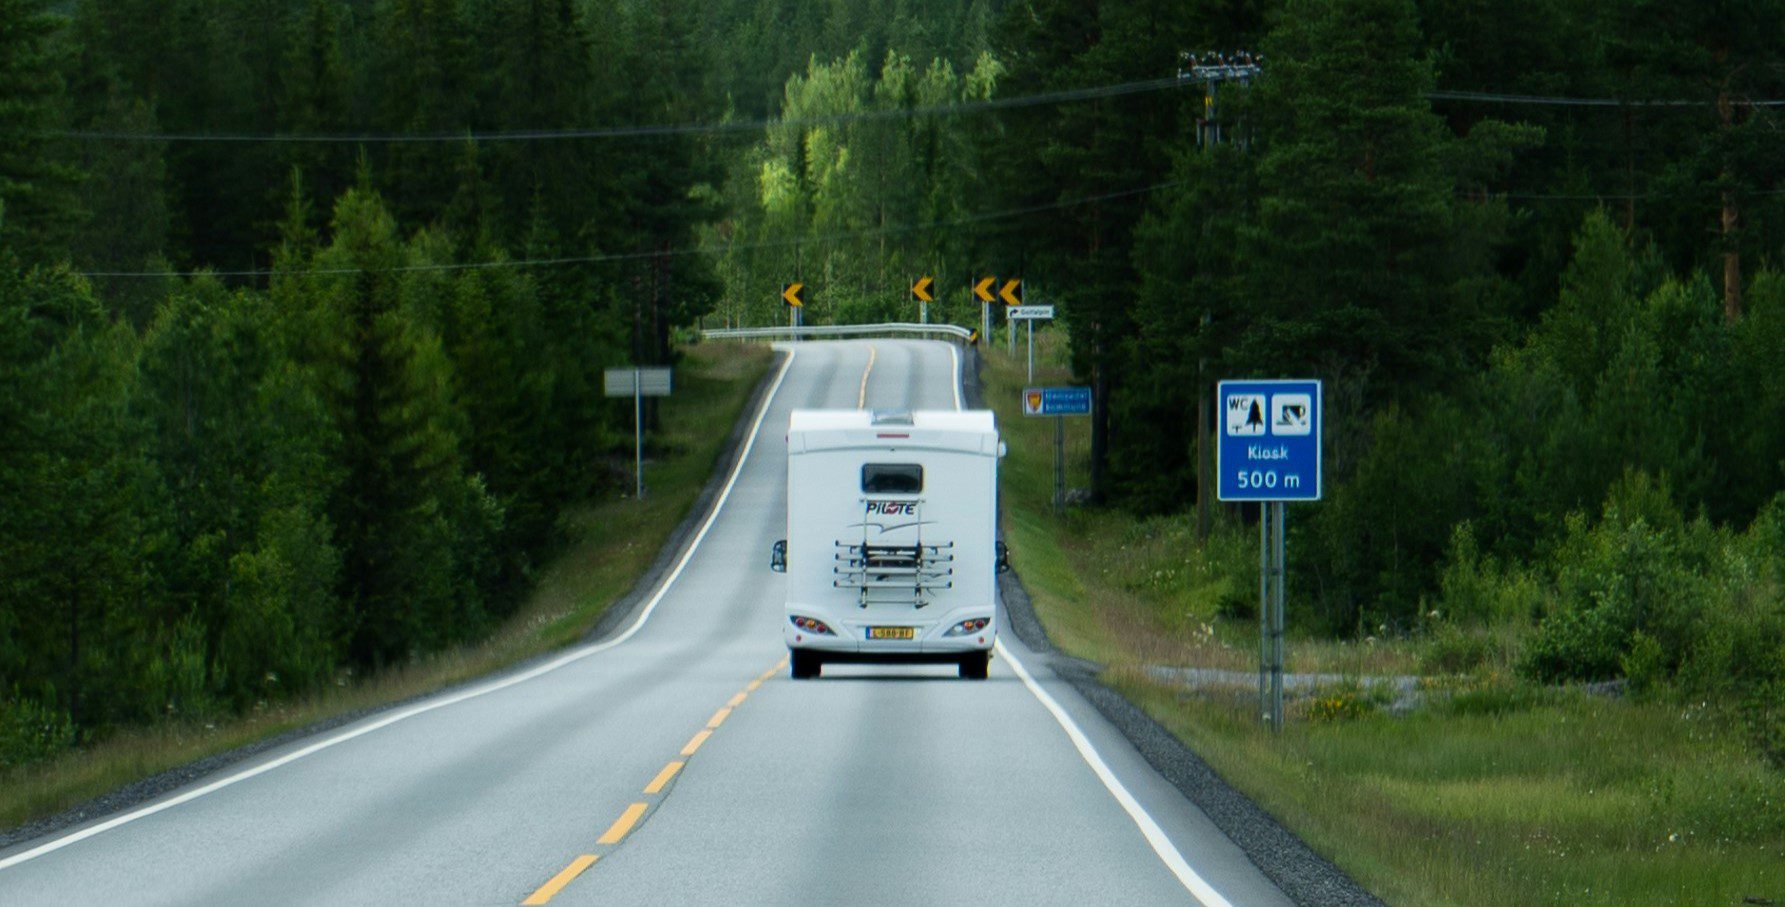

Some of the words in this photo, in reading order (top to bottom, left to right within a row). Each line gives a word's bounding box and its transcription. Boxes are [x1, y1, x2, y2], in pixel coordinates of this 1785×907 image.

[1229, 398, 1248, 411] WC
[1248, 445, 1288, 460] Kiosk
[1238, 471, 1277, 488] 500
[1284, 474, 1300, 488] m
[866, 501, 916, 515] PILOTE
